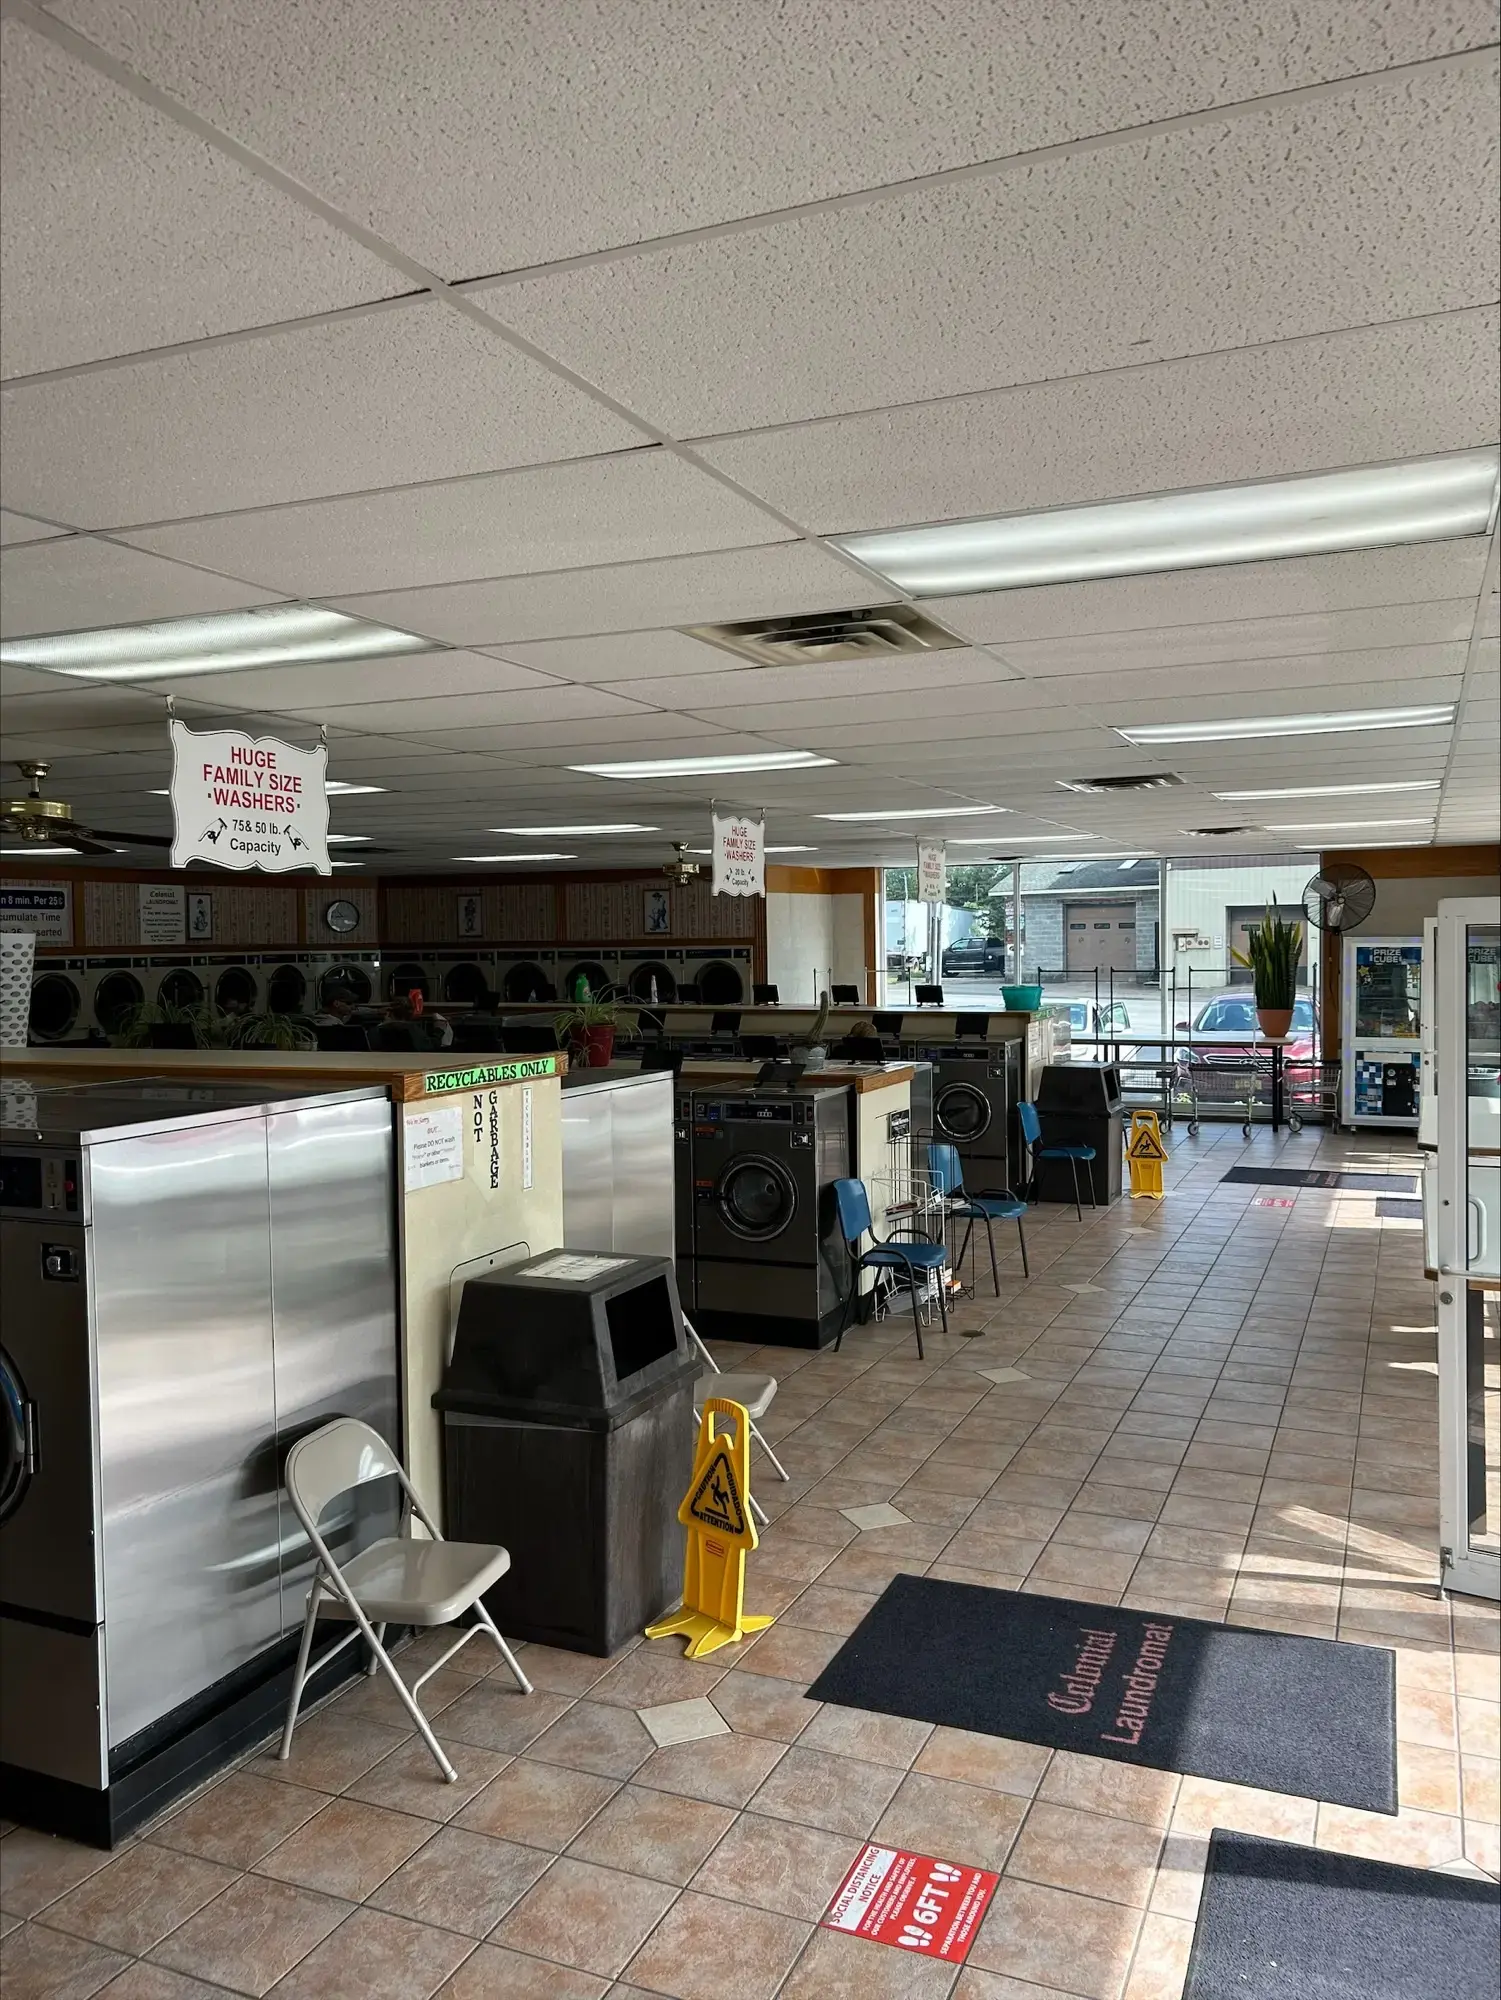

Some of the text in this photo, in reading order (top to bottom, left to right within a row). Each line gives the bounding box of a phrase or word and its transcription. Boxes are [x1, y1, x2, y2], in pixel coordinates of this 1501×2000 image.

[231, 746, 276, 769] HUGE
[203, 764, 302, 793] FAMILY SIZE
[213, 788, 295, 813] WASHERS
[232, 819, 281, 835] 75& 50 lb.
[732, 826, 747, 837] HUGE
[230, 838, 281, 856] Capacity
[723, 837, 756, 850] FAMILY SIZE
[732, 878, 749, 887] Capacity
[15, 896, 32, 905] min.
[33, 896, 47, 905] Per
[40, 913, 61, 922] Time
[1373, 948, 1402, 956] PRIZE
[1468, 948, 1497, 956] PRIZE
[427, 1059, 549, 1091] RECYCLABLES ONLY
[473, 1094, 483, 1143] NOT
[488, 1090, 499, 1189] GARBAGE
[696, 1464, 716, 1500] CAUTION
[726, 1472, 742, 1516] CUIDADO
[699, 1512, 736, 1534] ATTENTION
[1048, 1628, 1117, 1714] Colonial
[1101, 1622, 1174, 1745] Laundromat
[888, 1864, 903, 1881] SAFETY
[832, 1848, 880, 1924] SOCIAL DISTANCING
[857, 1873, 881, 1902] NOTICE
[883, 1881, 894, 1892] AND
[870, 1923, 882, 1935] OUR
[876, 1894, 897, 1924] CUSTOMERS
[892, 1884, 902, 1894] AND
[873, 1891, 888, 1910] HEALTH
[889, 1901, 904, 1920] PLEASE
[898, 1881, 914, 1902] OBSERVE
[913, 1883, 949, 1924] 6FT
[862, 1919, 873, 1931] FOR
[867, 1909, 878, 1920] THE
[939, 1872, 982, 1955] SEPARATION BETWEEN YOU AND
[956, 1923, 971, 1942] THOSE
[964, 1900, 981, 1924] AROUND
